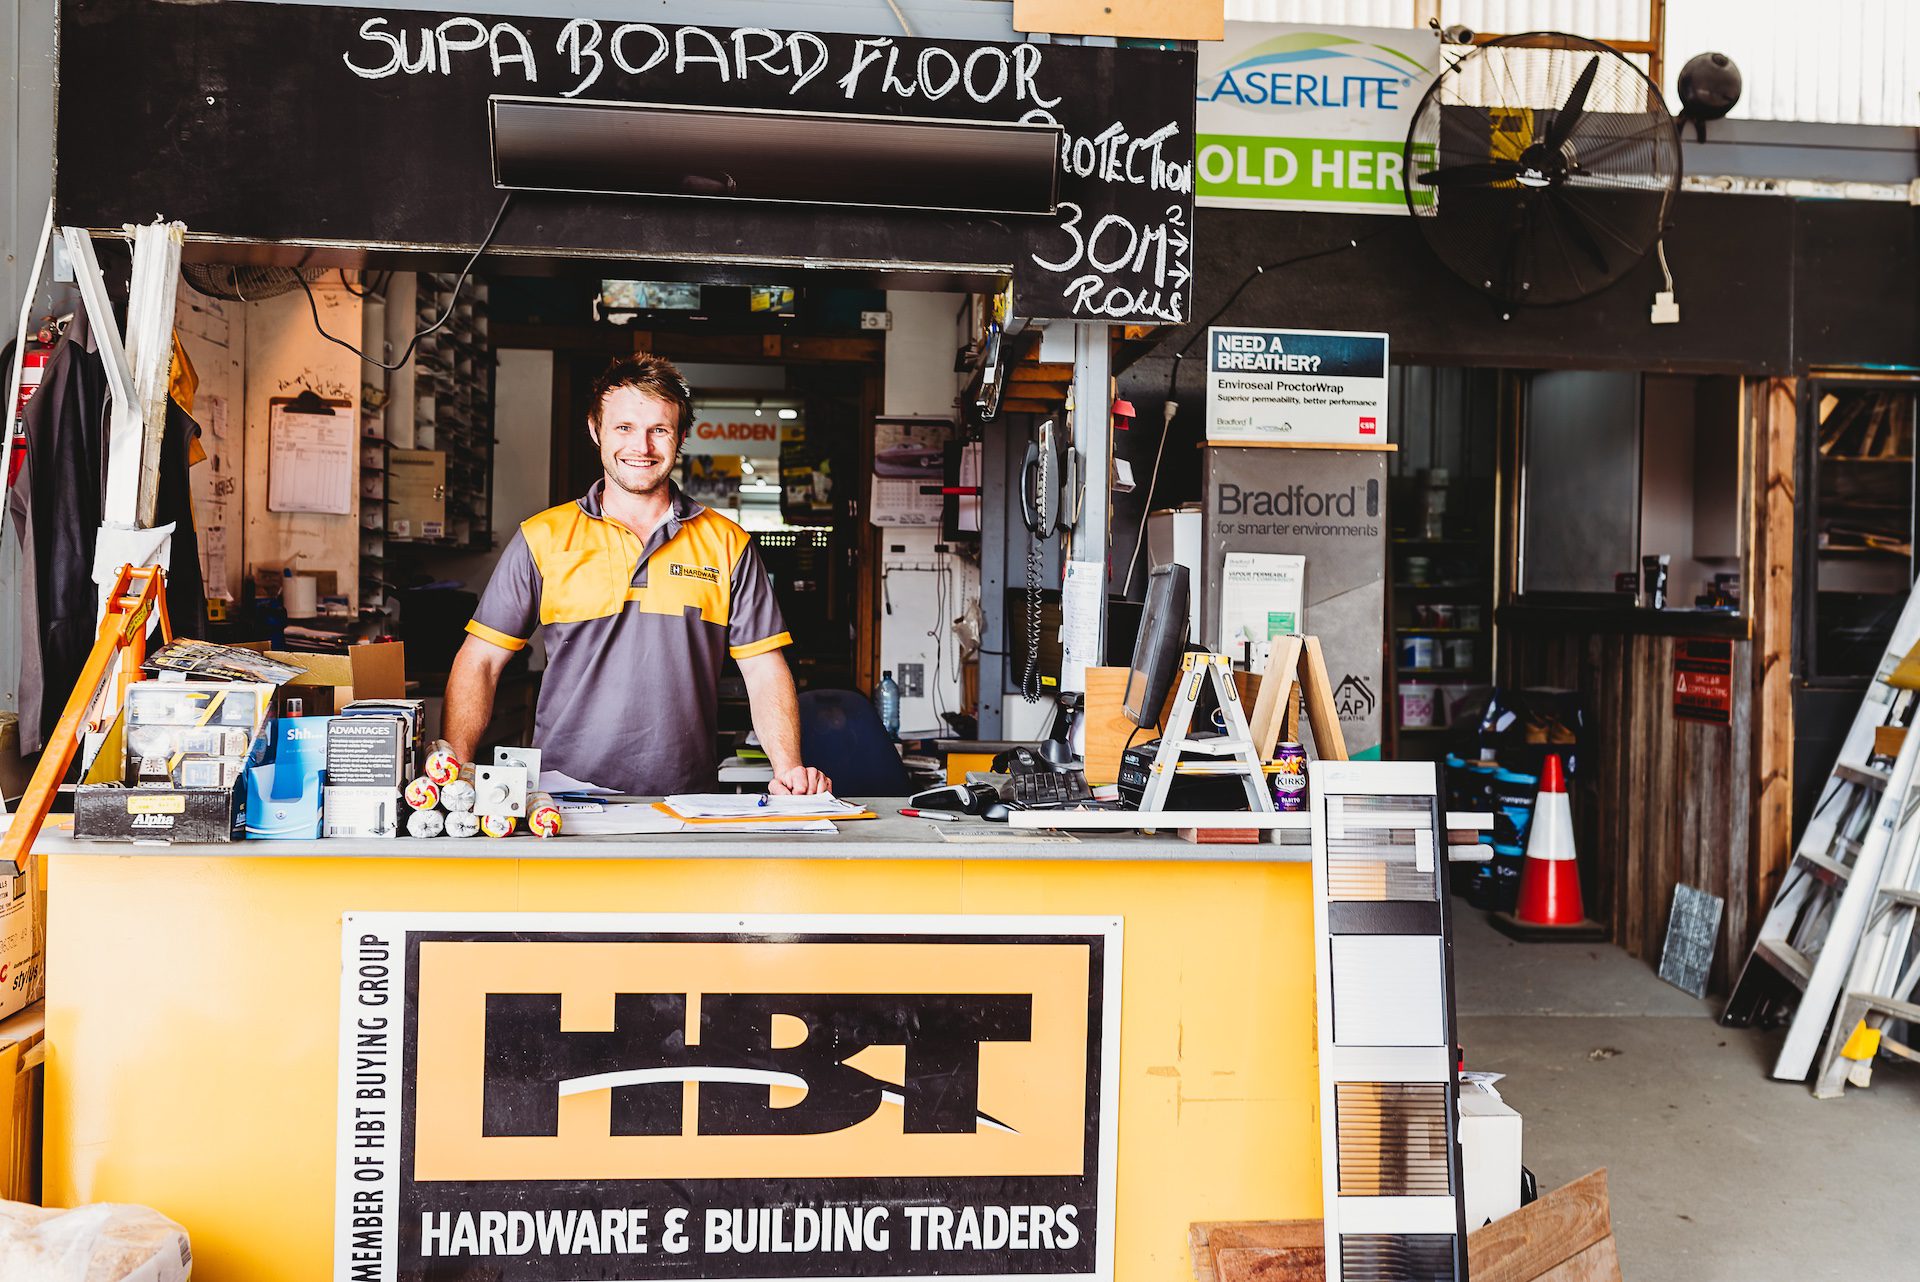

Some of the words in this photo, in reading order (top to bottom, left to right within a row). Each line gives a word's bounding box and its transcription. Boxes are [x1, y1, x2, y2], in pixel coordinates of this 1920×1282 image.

[556, 18, 829, 97] BOARD
[838, 36, 1061, 108] FLOOR
[1018, 109, 1192, 194] ROTECTION
[1063, 276, 1183, 323] ROLLS
[1218, 335, 1266, 353] NEED
[1270, 337, 1283, 353] A
[1218, 352, 1321, 372] BREATHER?
[1218, 379, 1273, 391] Enviroseal
[1277, 381, 1344, 395] ProctorWrap
[1217, 394, 1249, 403] Superior
[1252, 396, 1301, 405] permeability,
[1304, 397, 1326, 405] better
[1329, 398, 1377, 407] performance
[696, 423, 776, 441] GARDEN
[1218, 483, 1355, 518] Bradford
[1217, 521, 1235, 534] for
[1238, 523, 1289, 535] smarter
[1292, 522, 1378, 537] environments
[684, 569, 718, 580] HARDWARE
[329, 726, 390, 735] ADVANTAGES
[1278, 777, 1305, 786] KIRKS
[132, 813, 175, 827] Alpha
[358, 933, 390, 1006] GROUP
[356, 1017, 388, 1099] BUYING
[482, 992, 1033, 1137] HBT
[354, 1107, 386, 1148] HBT
[353, 1156, 384, 1182] OF
[351, 1189, 384, 1282] MEMBER
[421, 1208, 648, 1257] HARDWARE
[661, 1207, 689, 1254] &
[704, 1206, 890, 1254] BUILDING
[904, 1204, 1080, 1251] TRADERS
